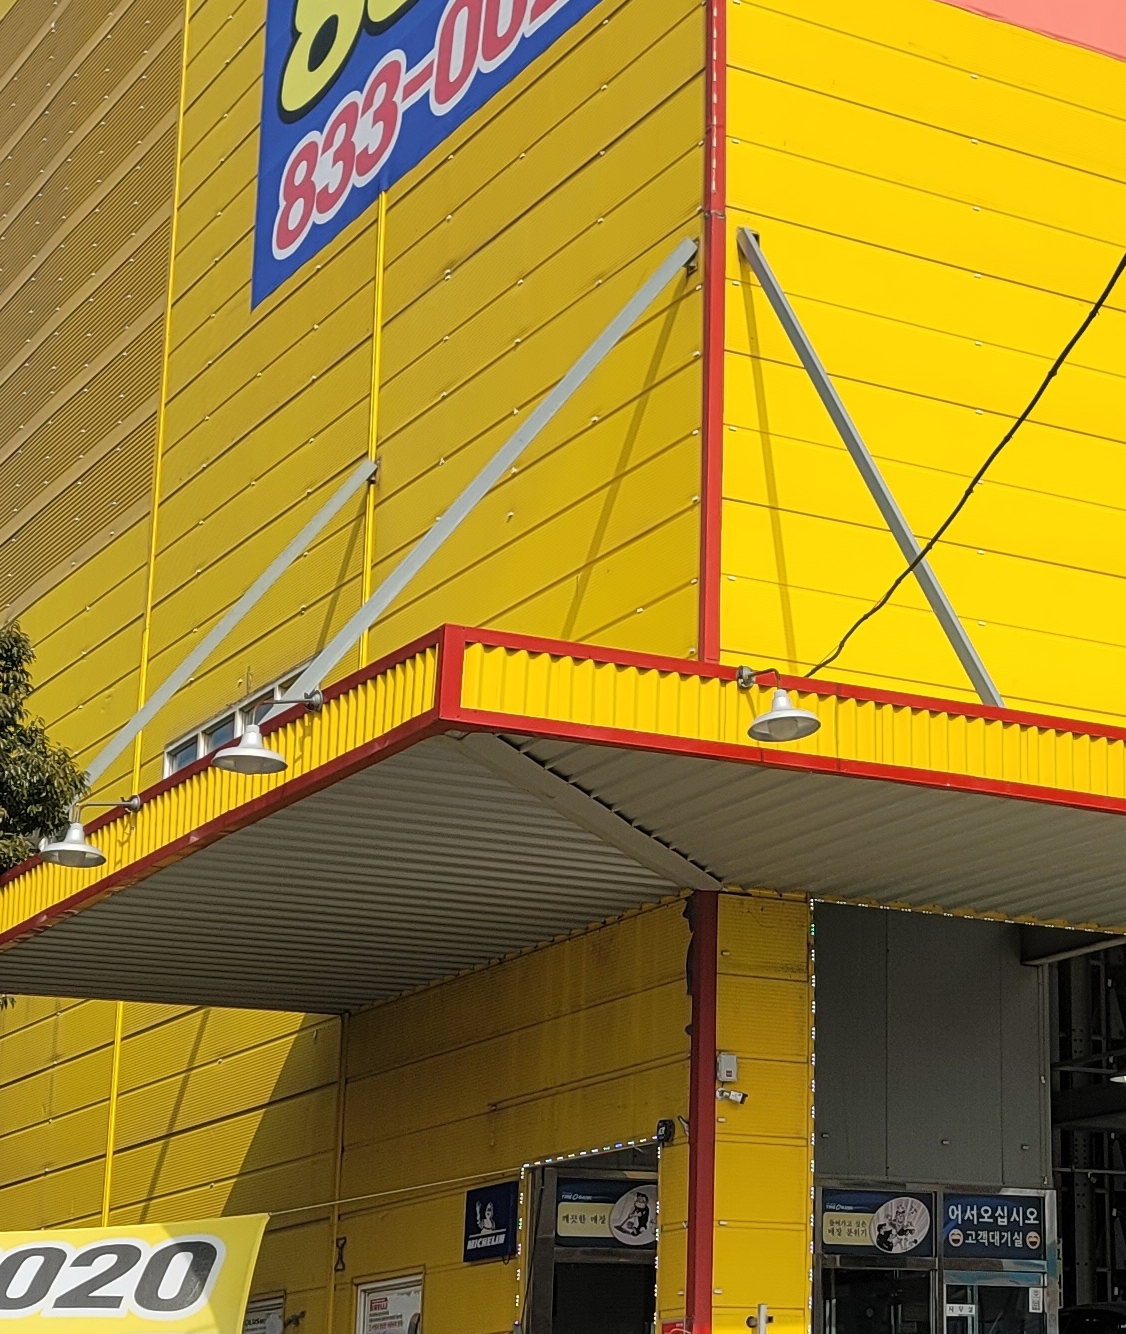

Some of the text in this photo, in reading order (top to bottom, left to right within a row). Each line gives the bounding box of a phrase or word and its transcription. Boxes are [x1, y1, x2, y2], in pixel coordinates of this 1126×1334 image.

[948, 1204, 1040, 1227] 어서오십시오
[467, 1233, 506, 1251] MICHELIN
[964, 1230, 1023, 1248] 고객대기실
